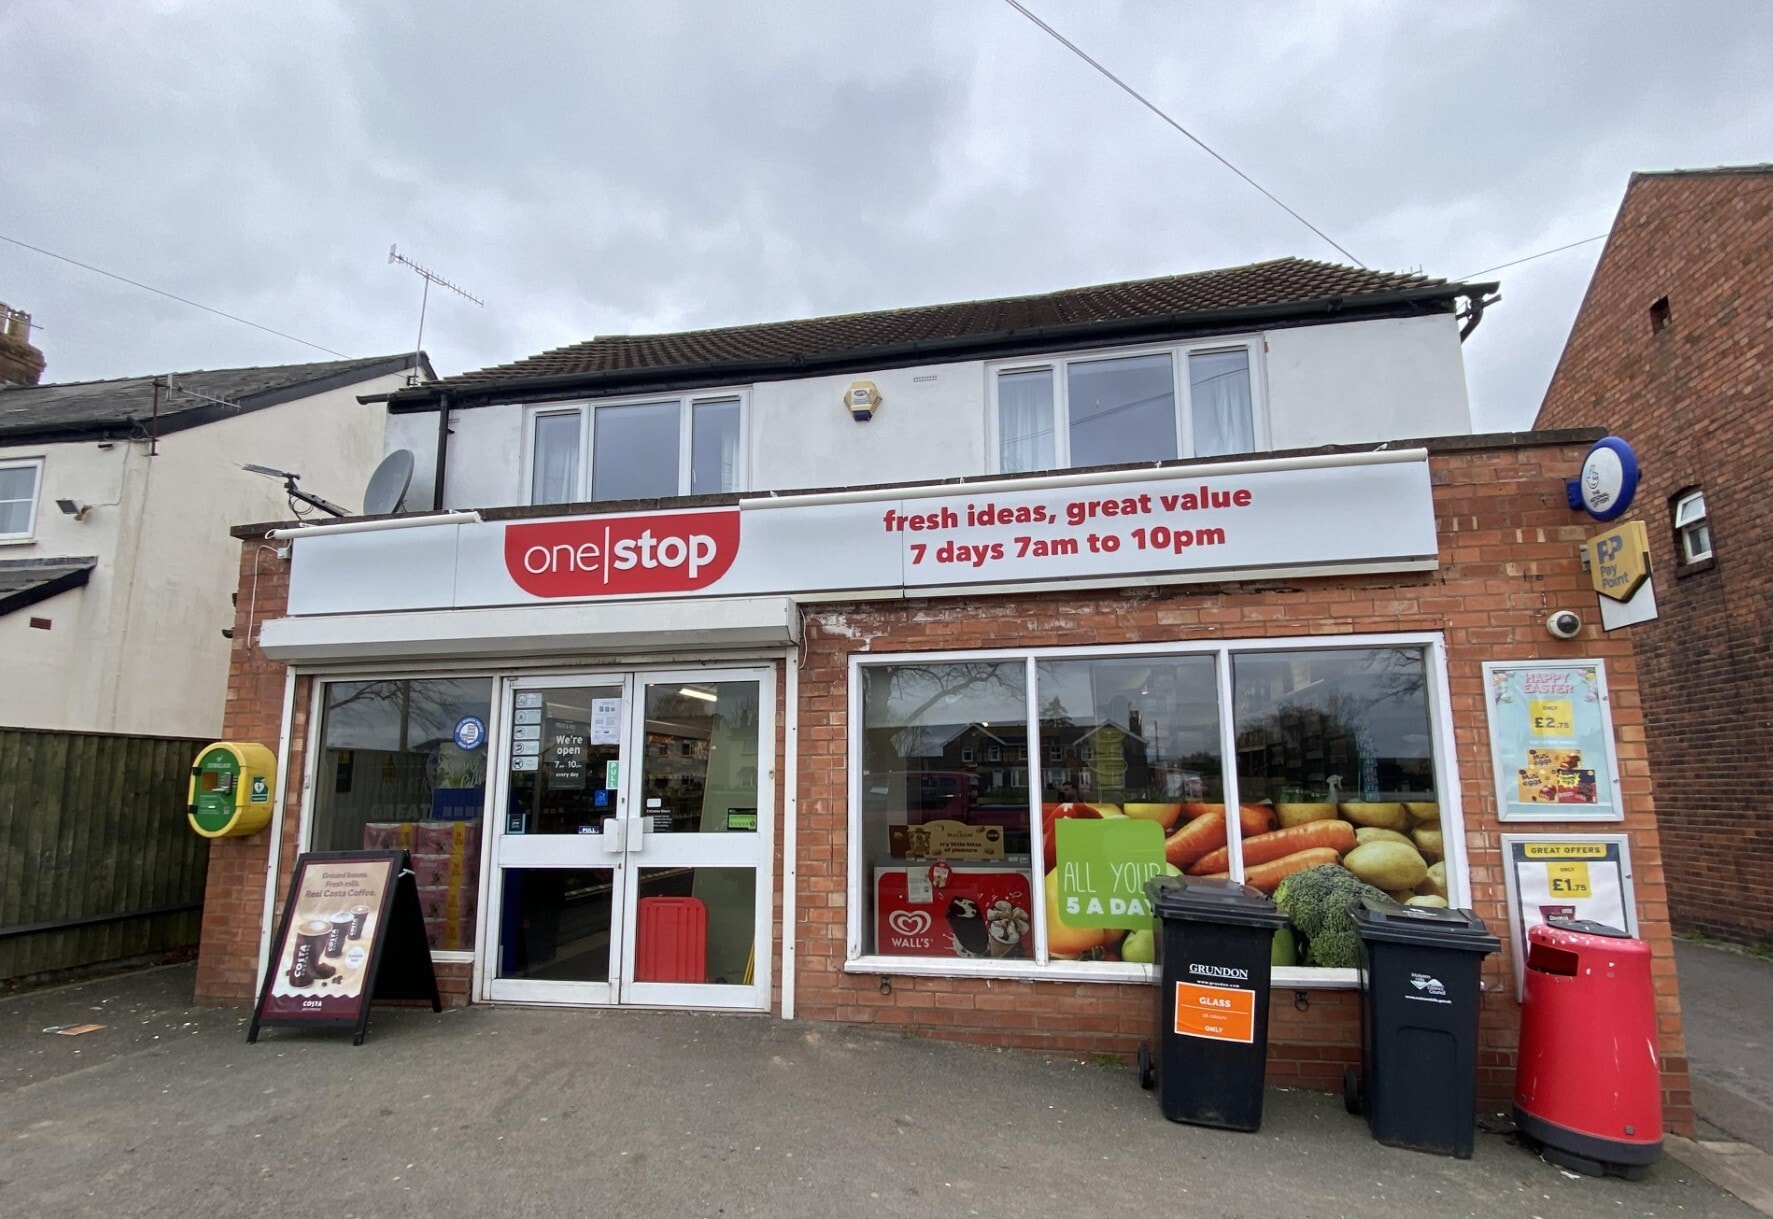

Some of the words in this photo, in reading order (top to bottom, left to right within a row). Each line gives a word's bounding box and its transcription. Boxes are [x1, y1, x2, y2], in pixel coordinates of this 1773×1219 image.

[883, 507, 958, 532] fresh
[968, 503, 1056, 527] ideas,
[1066, 494, 1152, 526] great
[1160, 486, 1252, 512] value
[910, 544, 927, 564] 7
[936, 540, 1004, 567] days
[1014, 536, 1078, 558] 7am
[1087, 534, 1120, 553] to
[1131, 525, 1226, 554] 10pm
[524, 543, 600, 574] one
[614, 528, 716, 578] stop
[1600, 564, 1617, 578] Pay
[1602, 572, 1629, 590] Point
[1525, 672, 1570, 684] HAPPY
[1523, 684, 1574, 694] EASTER
[1534, 717, 1570, 728] £2.75
[556, 735, 583, 744] We're
[556, 746, 580, 756] open
[1522, 778, 1542, 787] eggs
[1064, 862, 1096, 892] ALL
[1552, 878, 1587, 891] £1.75
[348, 889, 376, 897] Coffee.
[1066, 897, 1080, 914] 5
[1086, 898, 1104, 914] A
[1110, 898, 1153, 916] DAY
[328, 928, 337, 952] COSTA
[892, 938, 929, 948] WALL'S
[294, 944, 307, 978] COSTA
[1189, 964, 1248, 978] GRUNDON
[1199, 997, 1231, 1008] GLASS
